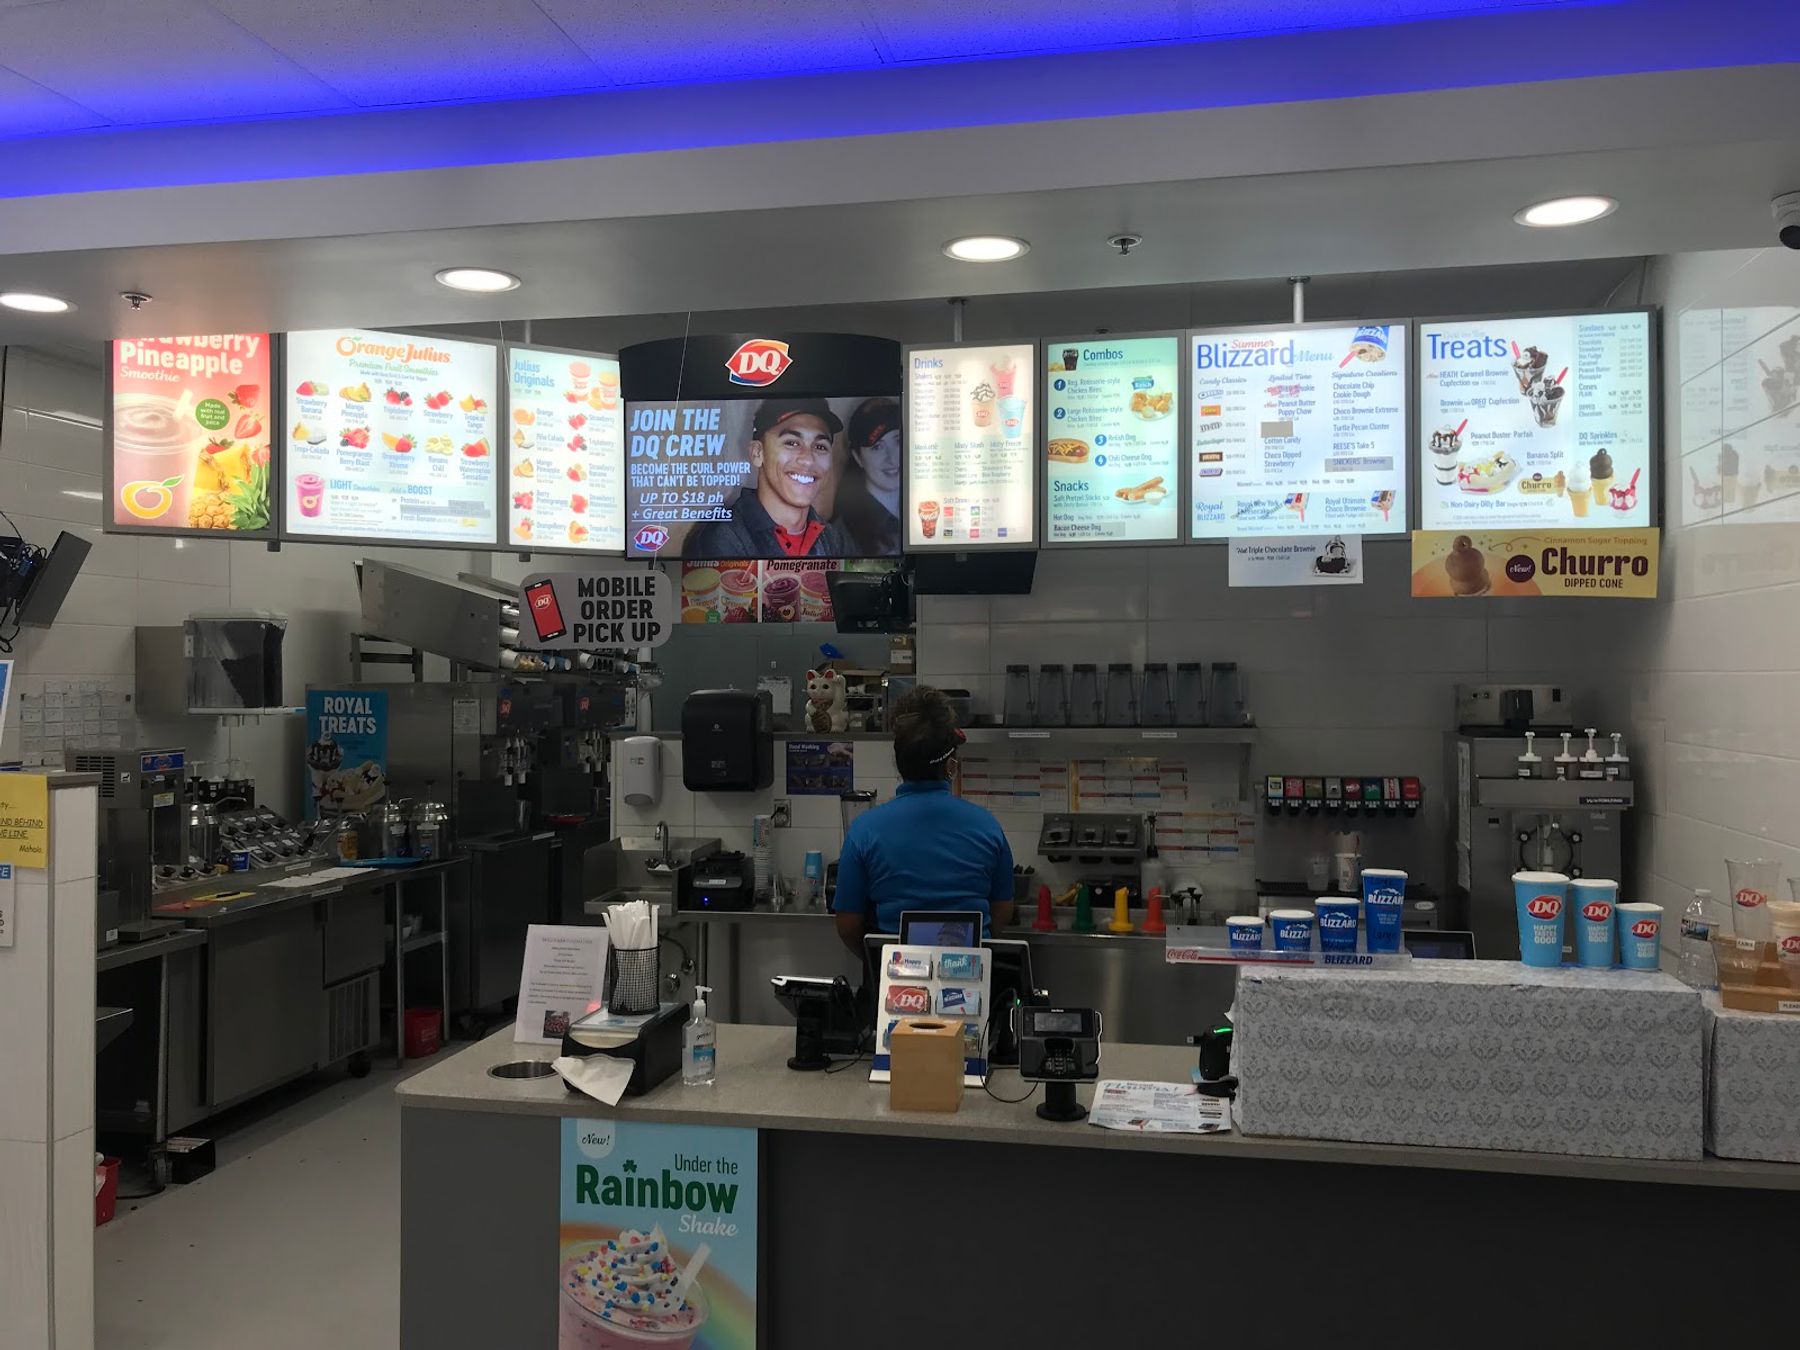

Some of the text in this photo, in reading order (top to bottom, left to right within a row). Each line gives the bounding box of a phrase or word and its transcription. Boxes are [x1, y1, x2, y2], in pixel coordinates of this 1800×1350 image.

[336, 336, 451, 364] Orange Julius
[1231, 339, 1274, 349] Summer
[1426, 333, 1508, 360] Treats
[119, 341, 243, 378] Pineapple
[1083, 348, 1124, 361] Combos
[1197, 339, 1334, 369] Blizzard Menu
[513, 360, 540, 374] Julius
[739, 350, 781, 375] DQ
[914, 357, 944, 369] Drinks
[120, 366, 181, 382] Smoothie
[513, 373, 555, 388] Originals
[1460, 370, 1484, 378] Caramel
[1057, 381, 1062, 389] 1
[1333, 382, 1361, 390] Chocolate
[1333, 390, 1371, 400] Cookie Dough
[1057, 409, 1062, 417] 2
[630, 408, 721, 432] JOIN THE
[1333, 423, 1350, 432] Turtle
[1351, 423, 1369, 431] Pecan
[665, 434, 726, 456] CREW
[1550, 450, 1564, 459] Split
[631, 461, 751, 475] BECOME THE CURL POWER
[329, 479, 352, 490] LIGHT
[631, 474, 741, 487] THAT CAN'T BE TOPPED!
[1053, 480, 1089, 492] Snacks
[1521, 481, 1552, 489] Churro
[407, 485, 433, 496] BOOST
[639, 491, 724, 506] UP TO $18 ph
[642, 507, 678, 520] Great
[681, 506, 733, 520] Benefits
[1196, 513, 1226, 521] BLIZZARD
[640, 530, 664, 544] DQ
[1587, 537, 1611, 545] Sugar
[1614, 536, 1648, 545] Topping
[1248, 546, 1264, 555] Triple
[1293, 545, 1316, 553] Brownie
[767, 560, 837, 573] Pomegranate
[1542, 546, 1649, 577] Churro
[577, 576, 656, 598] MOBILE
[1564, 578, 1624, 589] DIPPED CONE
[580, 598, 653, 620] ORDER
[573, 621, 661, 643] PICK UP
[323, 696, 373, 715] ROYAL
[319, 715, 377, 734] TREATS
[15, 818, 43, 828] BEHIND
[1739, 893, 1760, 904] DQ
[1533, 900, 1560, 914] DQ
[1587, 905, 1610, 917] DQ
[1320, 918, 1357, 928] BLIZZARD
[1637, 923, 1657, 934] DQ
[1534, 936, 1557, 944] GOOD
[1324, 955, 1373, 965] BLIZZARD
[901, 994, 923, 1008] DQ
[581, 1133, 611, 1146] New!
[674, 1153, 738, 1175] Under the
[576, 1159, 739, 1214] Rainbow
[678, 1213, 739, 1237] Shake
